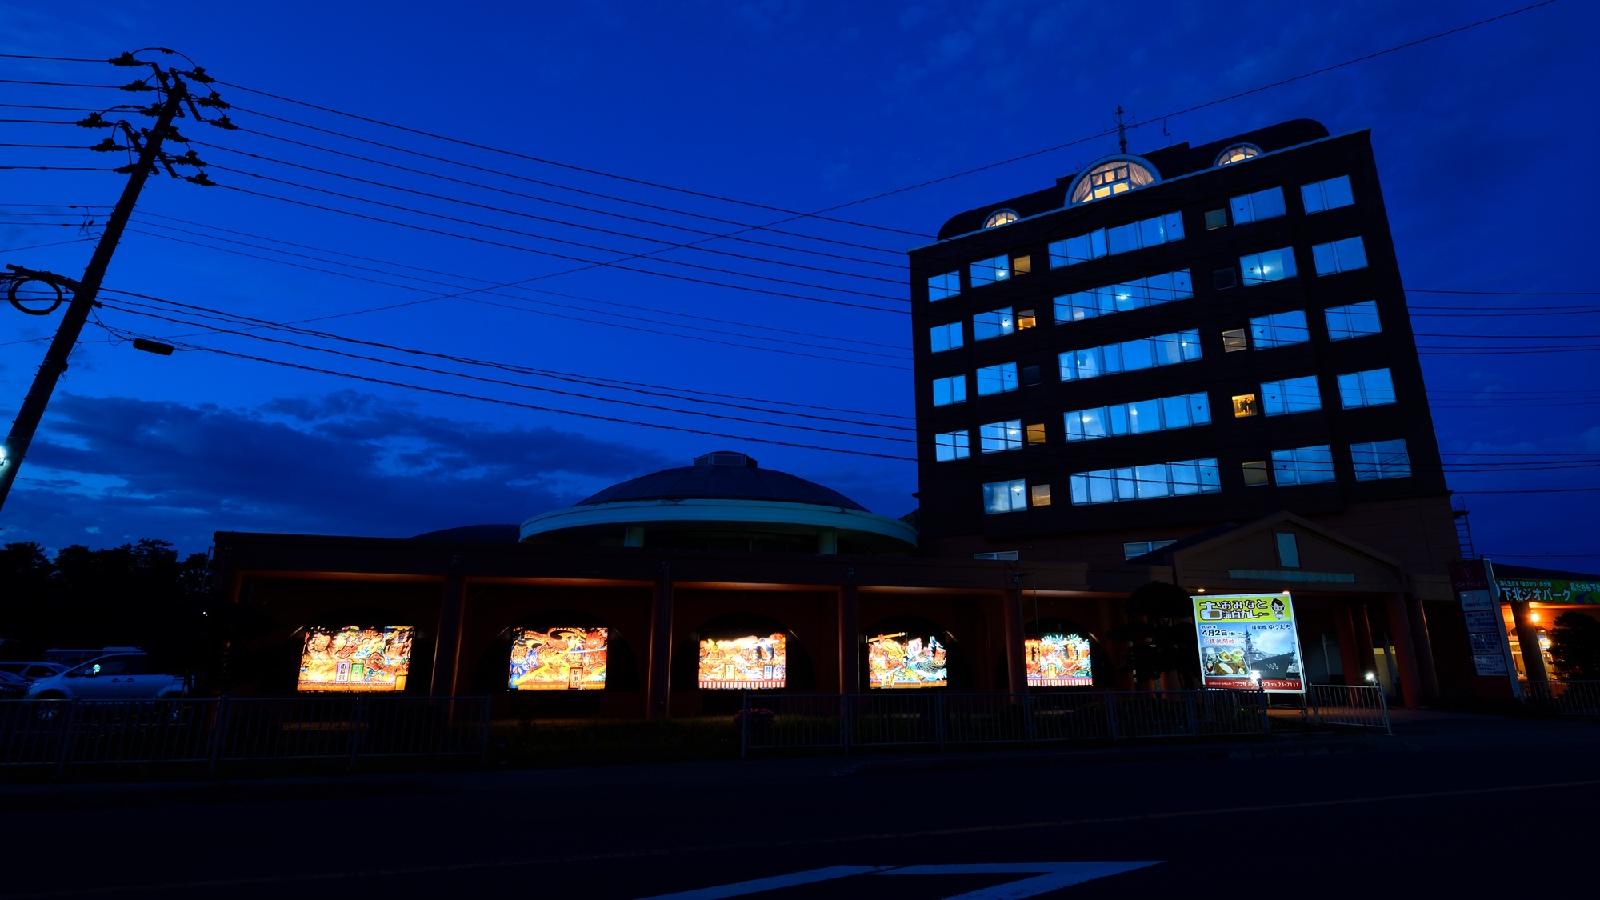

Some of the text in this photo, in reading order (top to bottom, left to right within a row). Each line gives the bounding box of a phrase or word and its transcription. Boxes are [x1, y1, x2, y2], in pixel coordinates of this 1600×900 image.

[1501, 587, 1571, 601] 下北ジオパーク
